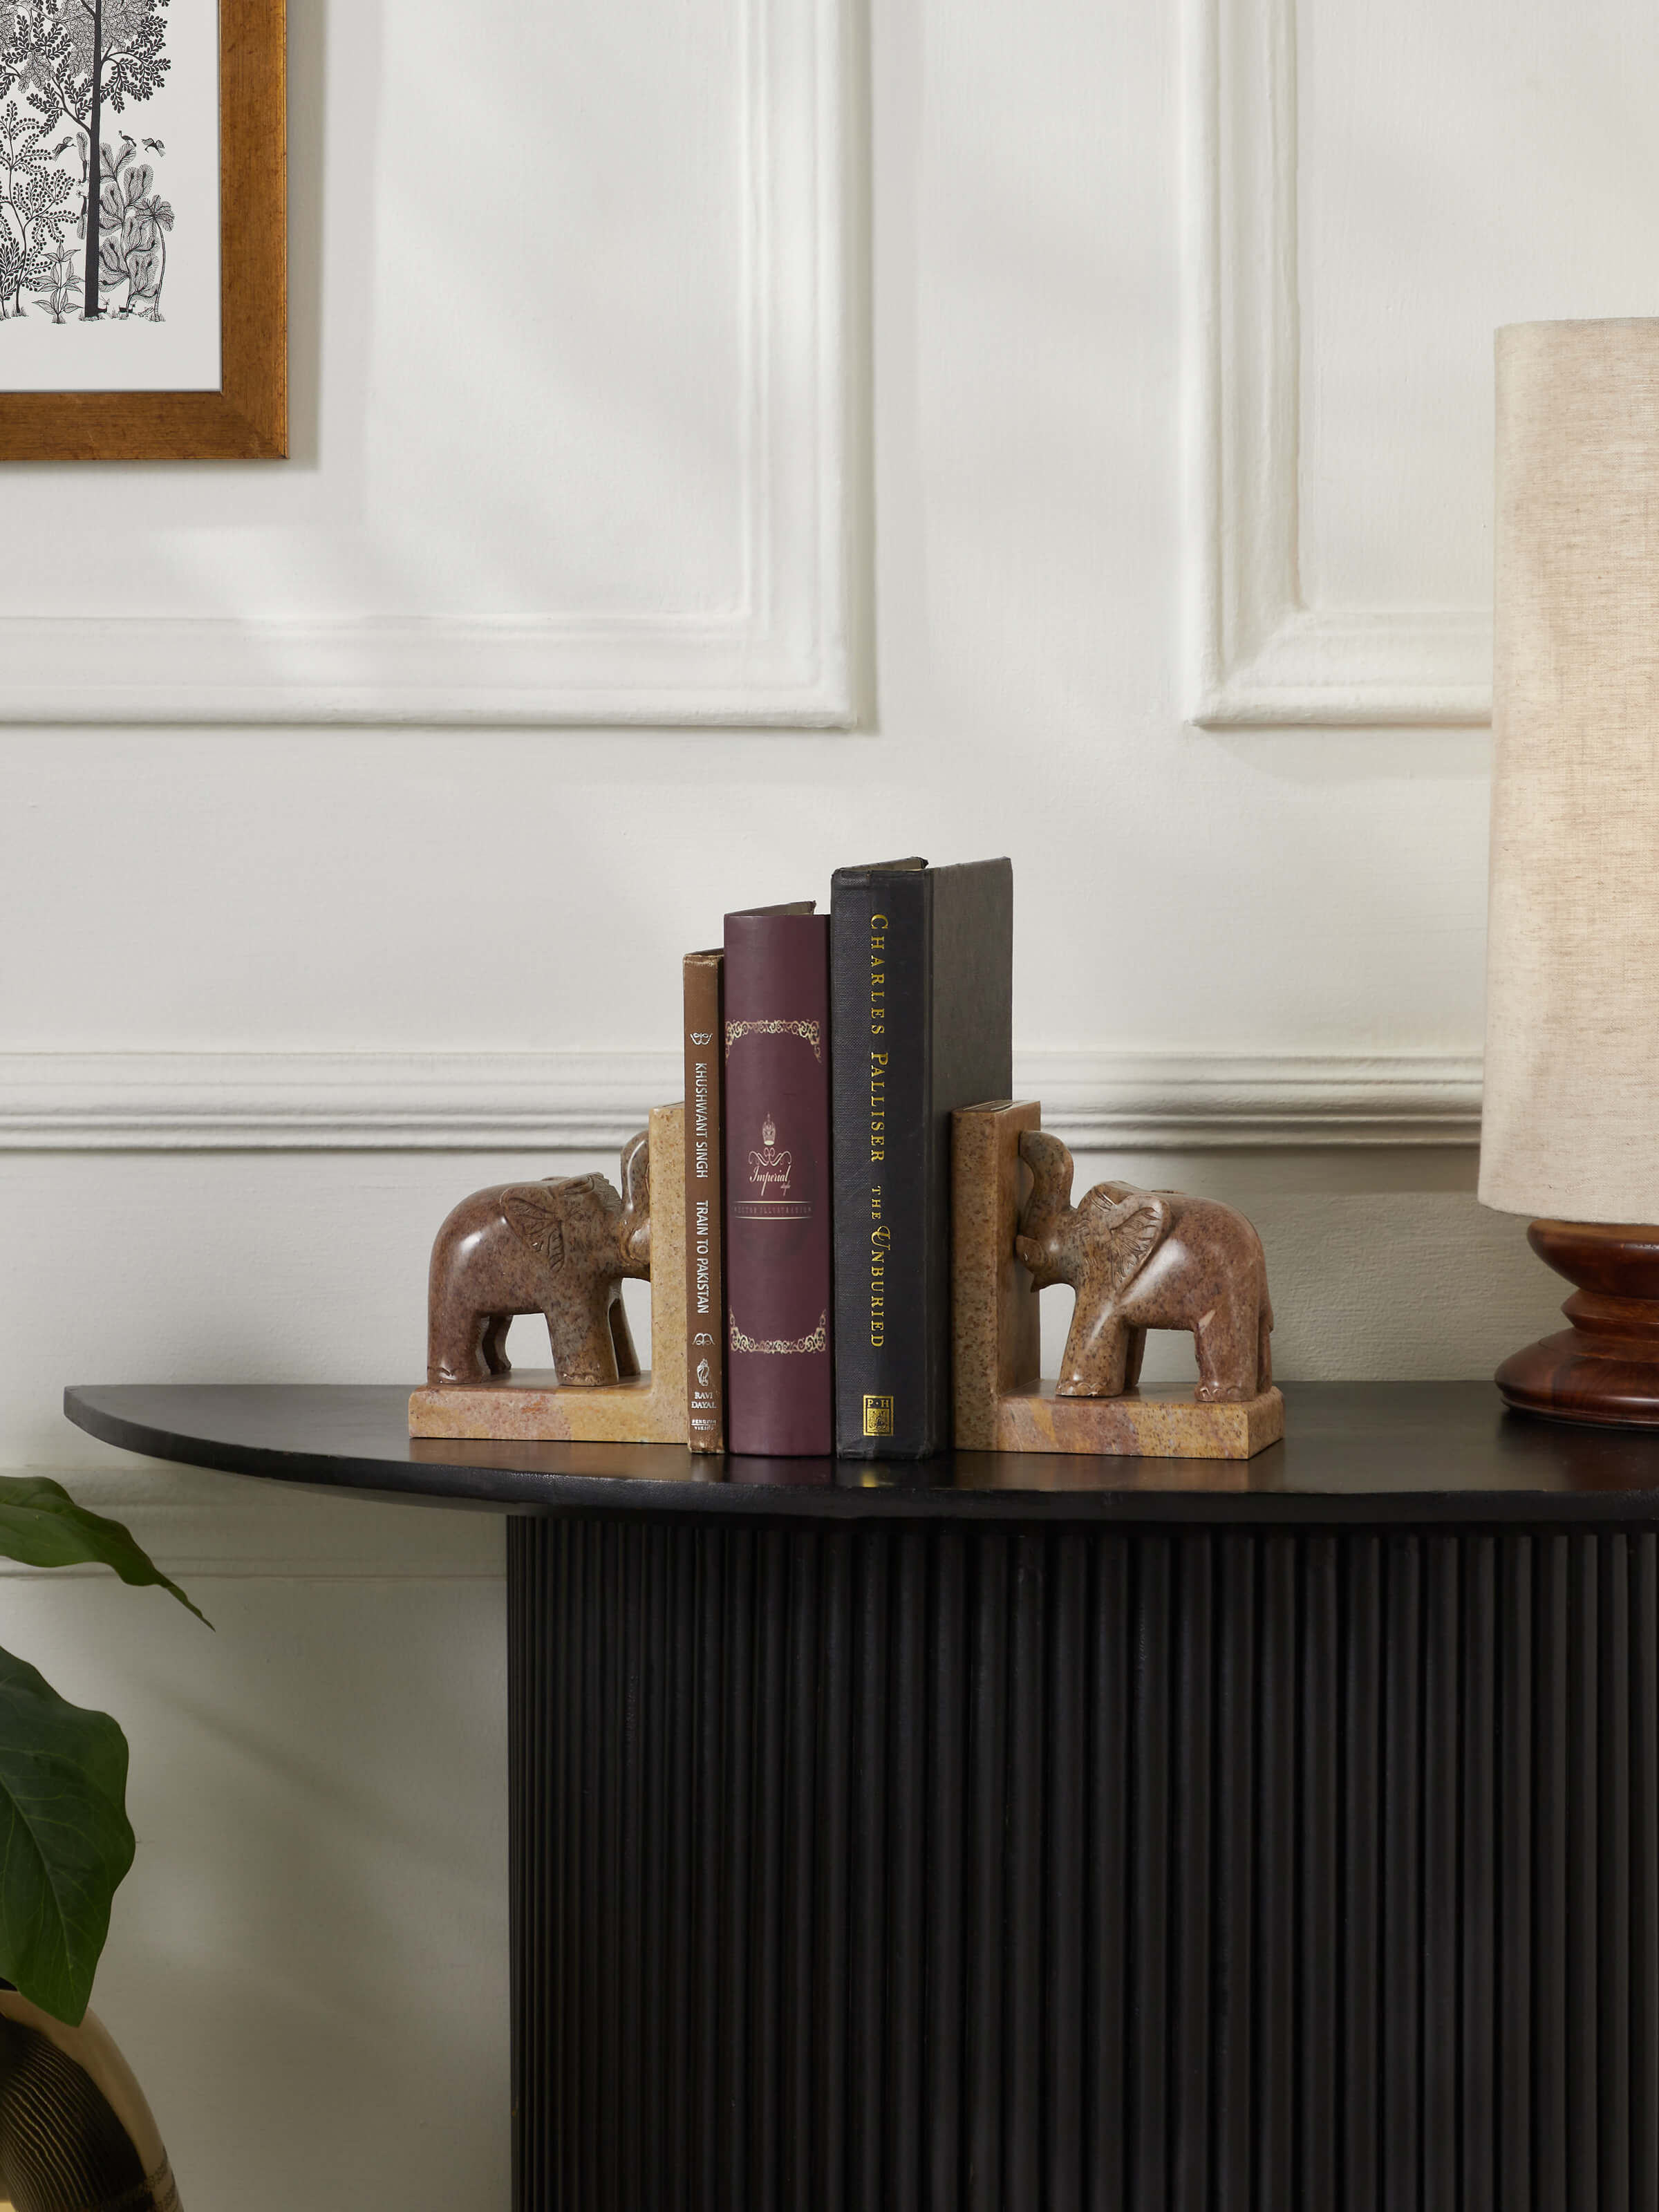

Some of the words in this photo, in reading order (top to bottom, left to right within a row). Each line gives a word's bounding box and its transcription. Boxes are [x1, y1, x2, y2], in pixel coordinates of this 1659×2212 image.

[871, 914, 889, 1035] CHARLES
[695, 1062, 708, 1138] KHUSHWANT
[871, 1052, 889, 1162] PALLISER
[696, 1141, 709, 1178] SINGH
[749, 1165, 791, 1197] Imperial
[696, 1200, 709, 1235] TRAIN
[871, 1186, 881, 1219] THE
[696, 1239, 709, 1255] TO
[697, 1257, 709, 1313] PAKISTAN
[871, 1226, 891, 1347] UNBURIED
